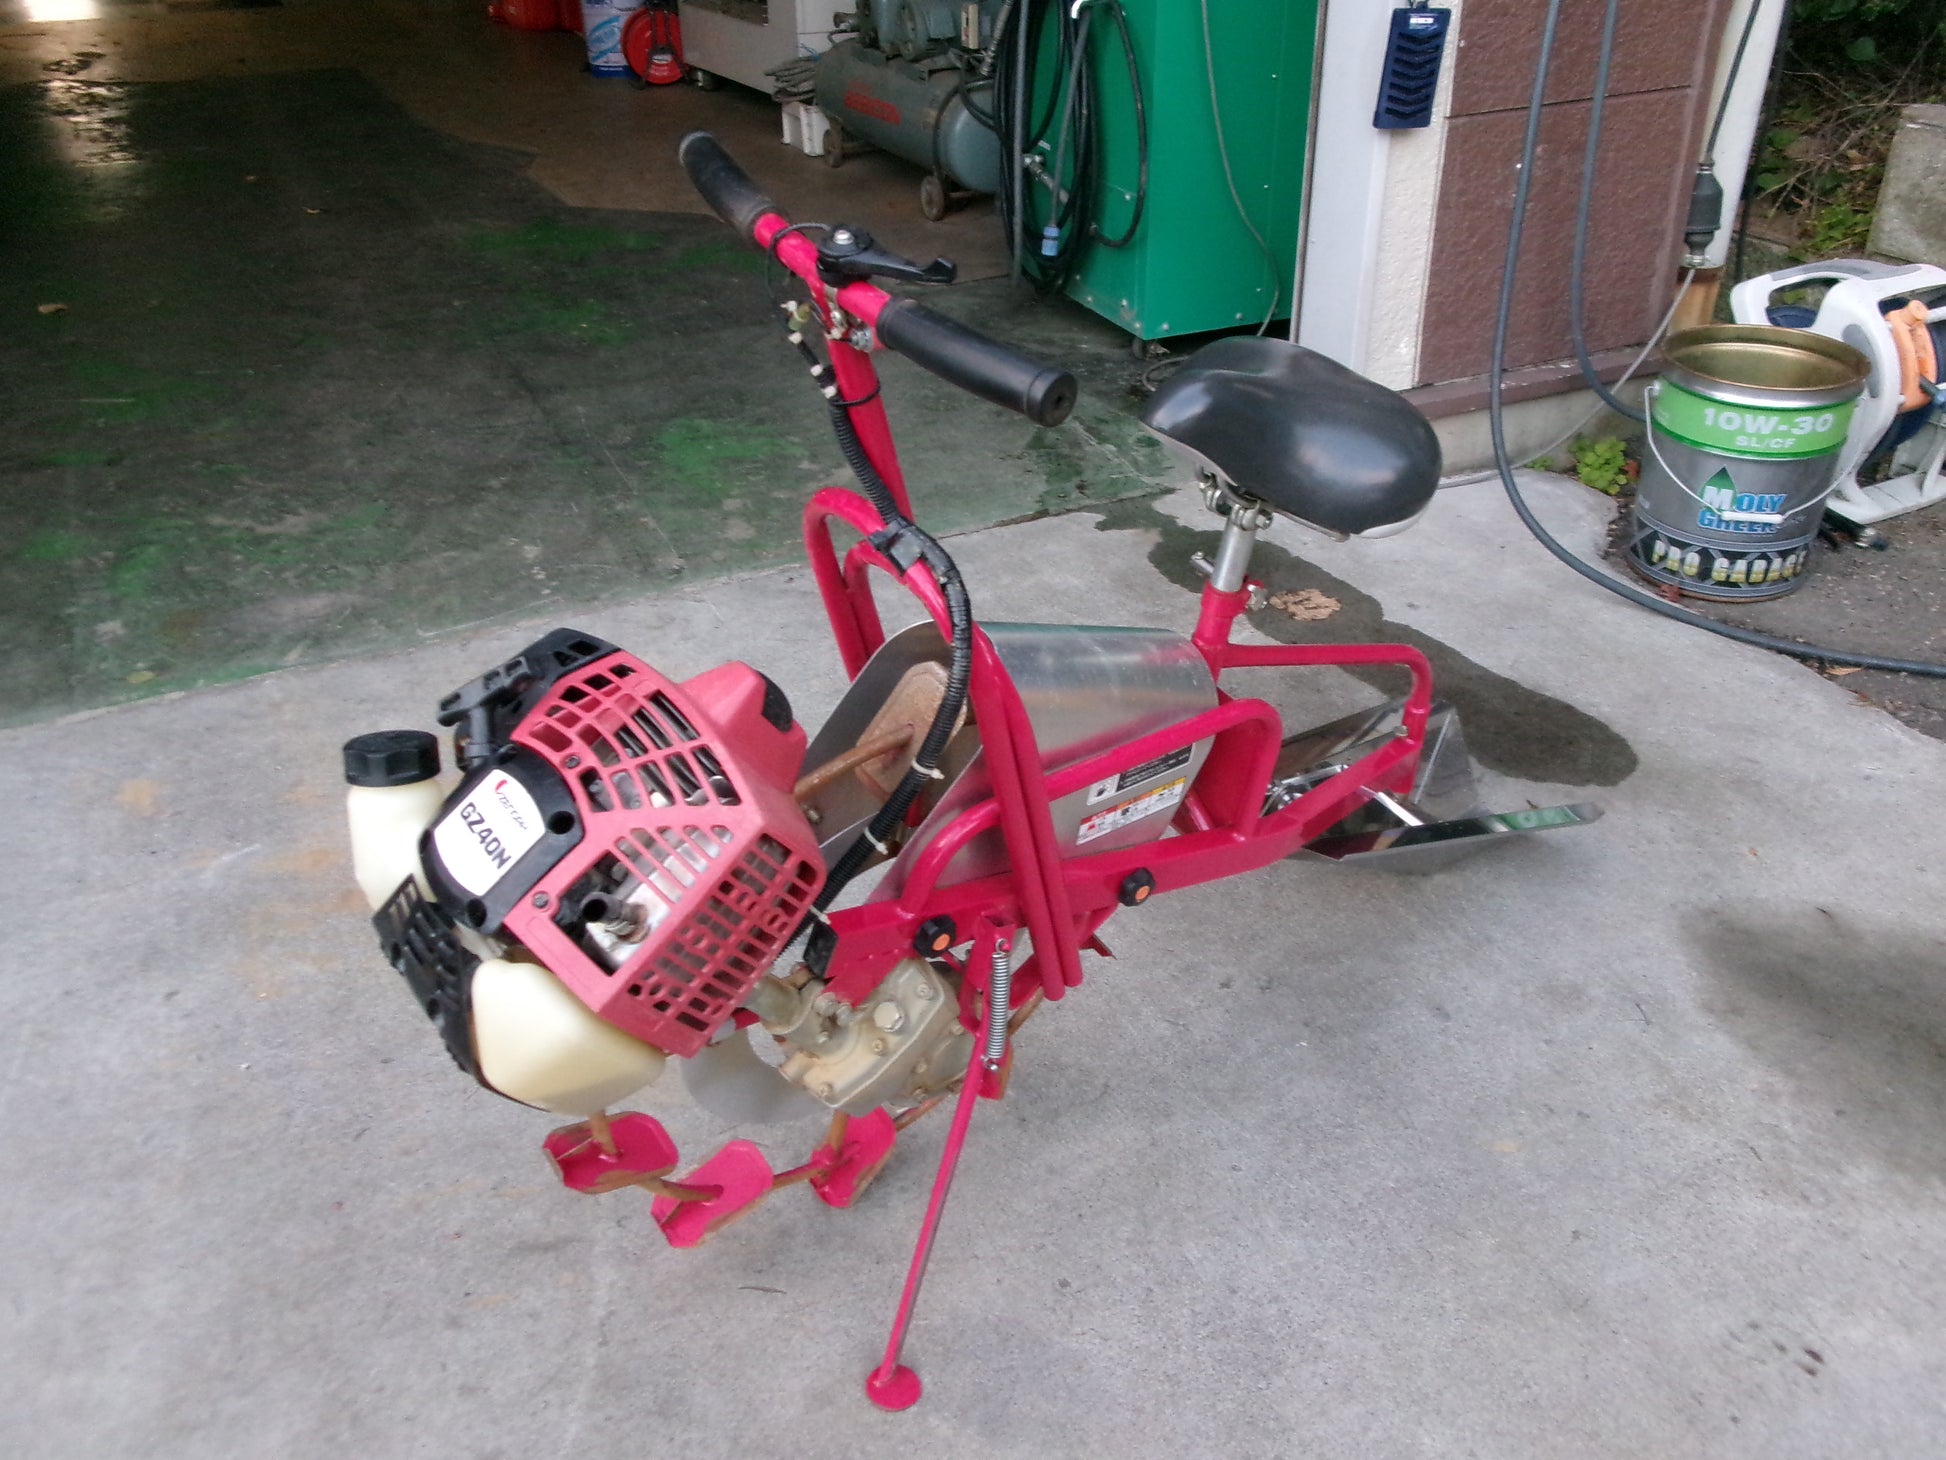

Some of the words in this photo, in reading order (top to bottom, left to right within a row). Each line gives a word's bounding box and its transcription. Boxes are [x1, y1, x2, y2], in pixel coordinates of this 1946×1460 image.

[1705, 408, 1833, 434] 10W-30
[1736, 437, 1795, 448] SL/CF
[1702, 486, 1787, 514] MOLY
[460, 802, 511, 869] GZ40N
